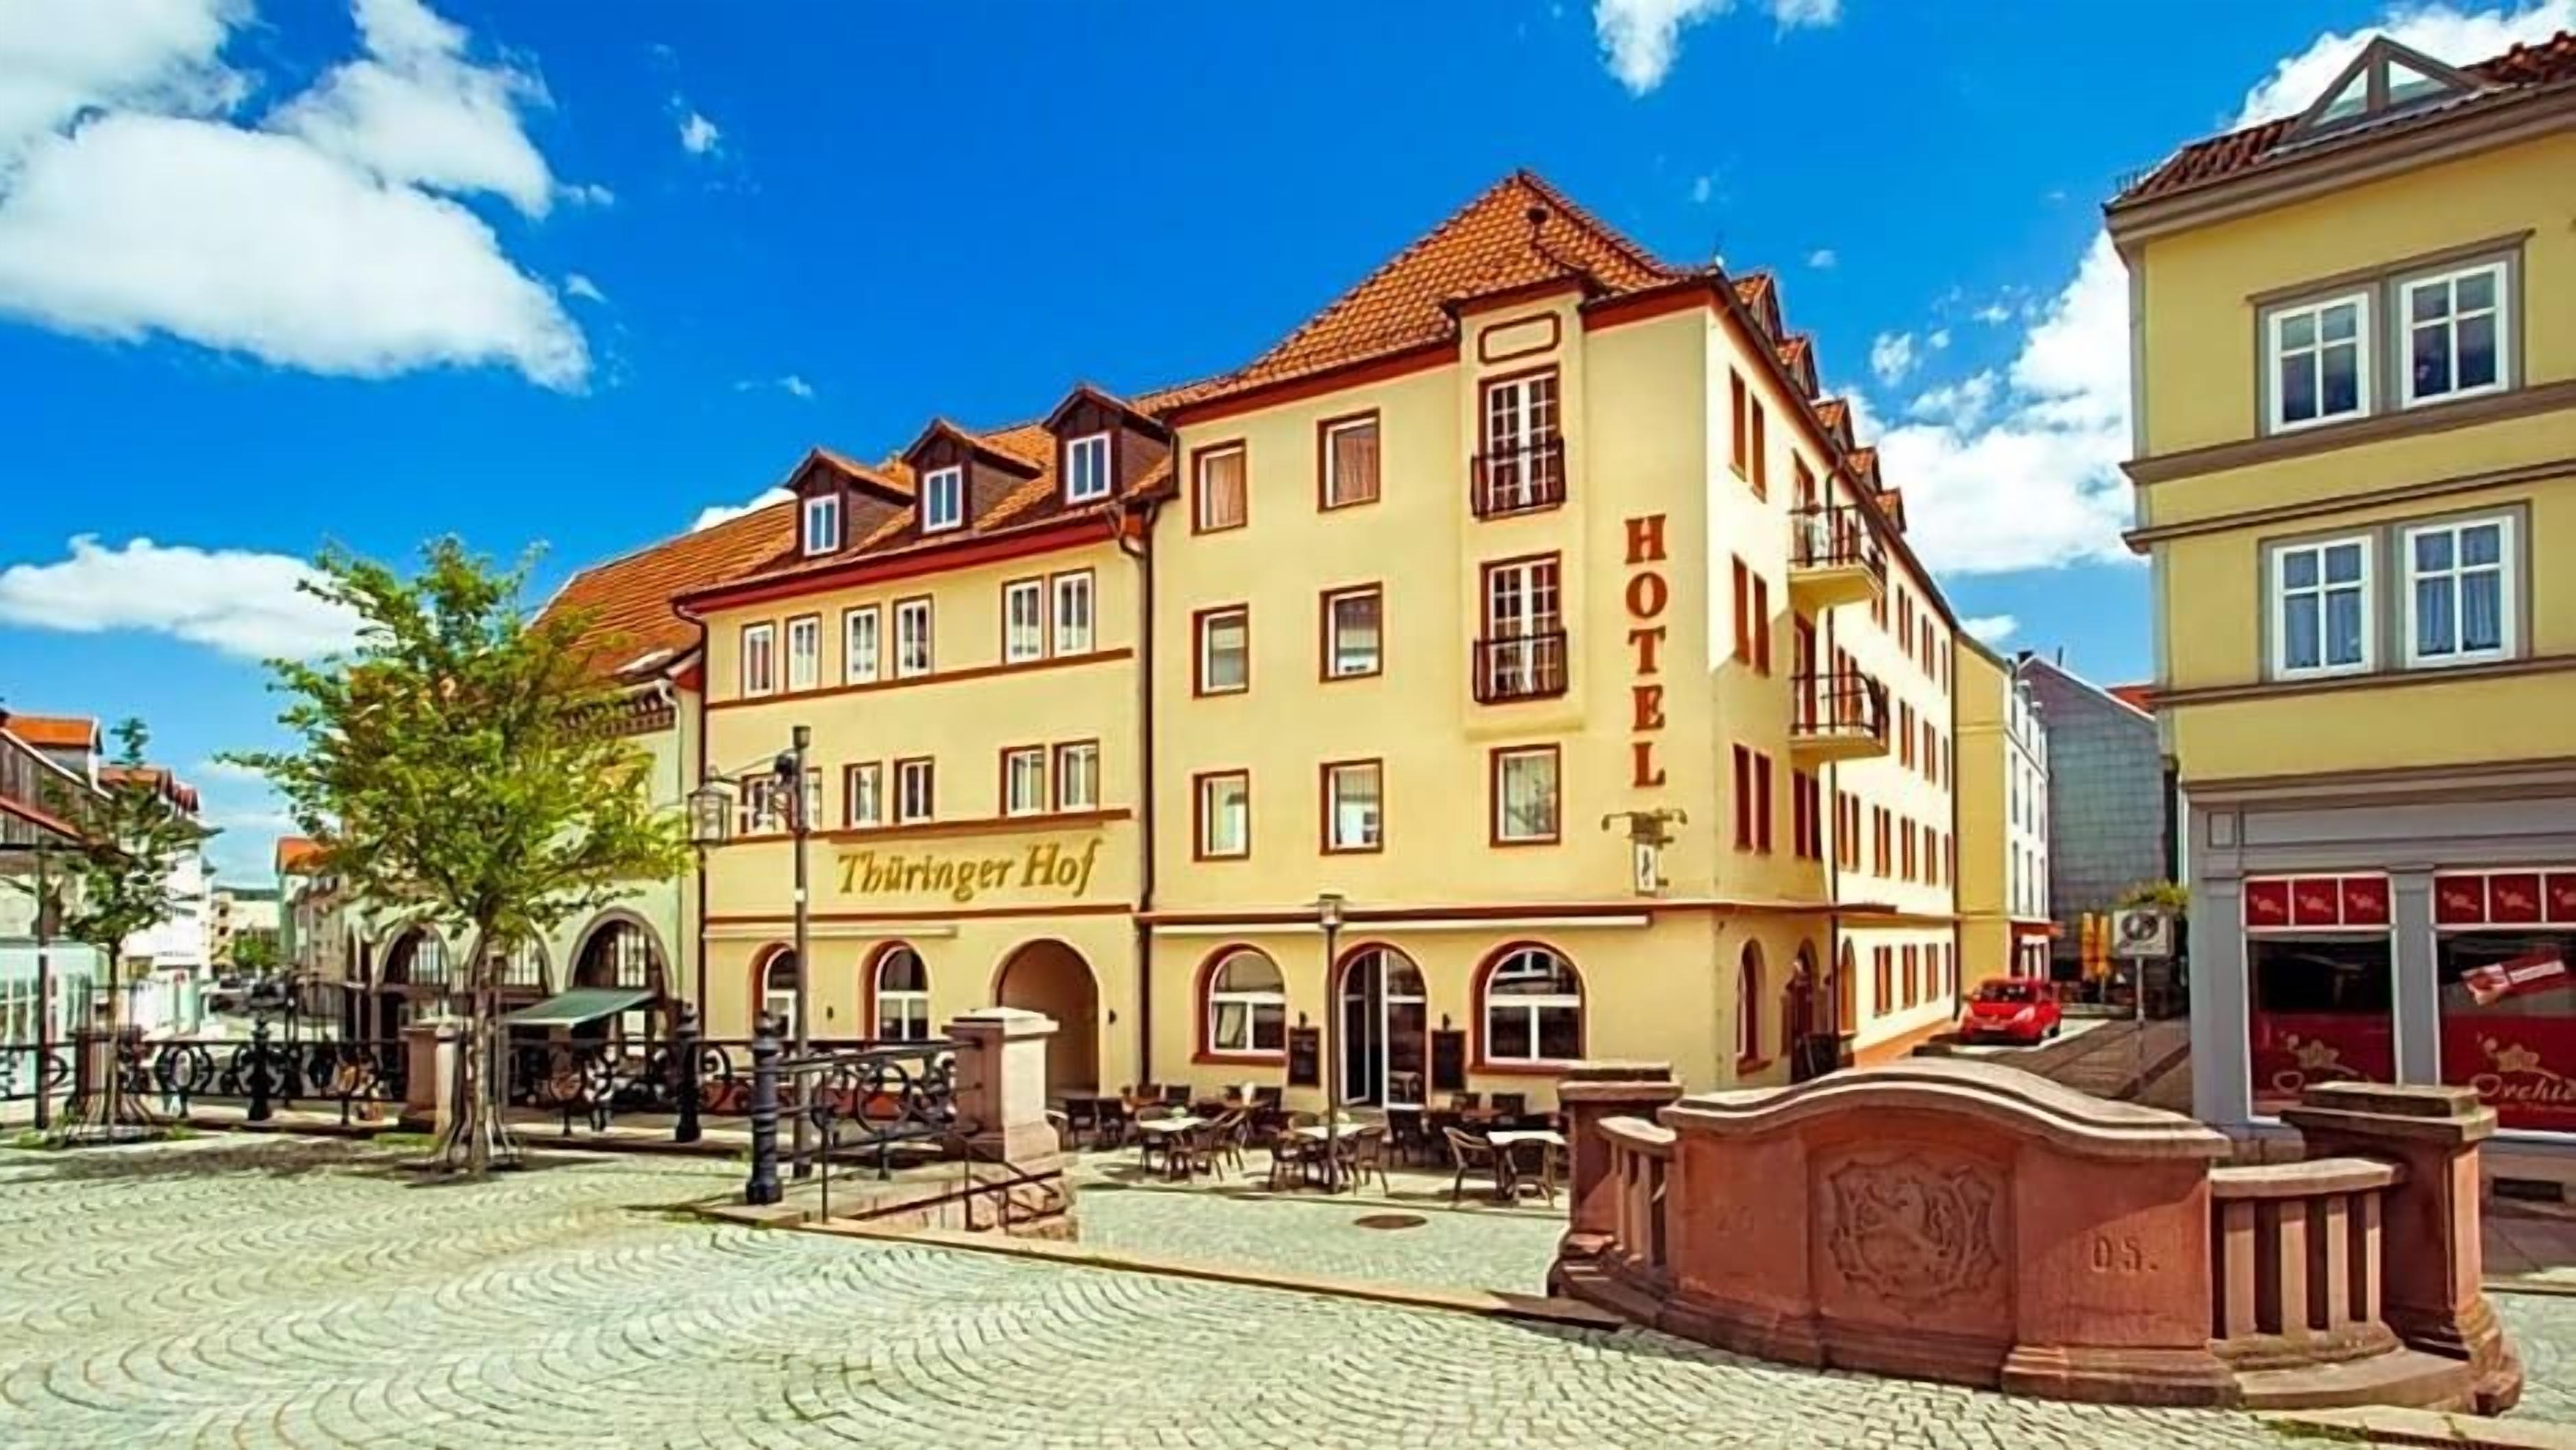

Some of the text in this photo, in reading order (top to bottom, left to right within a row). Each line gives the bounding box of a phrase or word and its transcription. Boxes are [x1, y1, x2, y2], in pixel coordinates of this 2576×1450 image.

[1624, 513, 1668, 789] HOTEL
[837, 837, 1104, 902] Thüringer Hof
